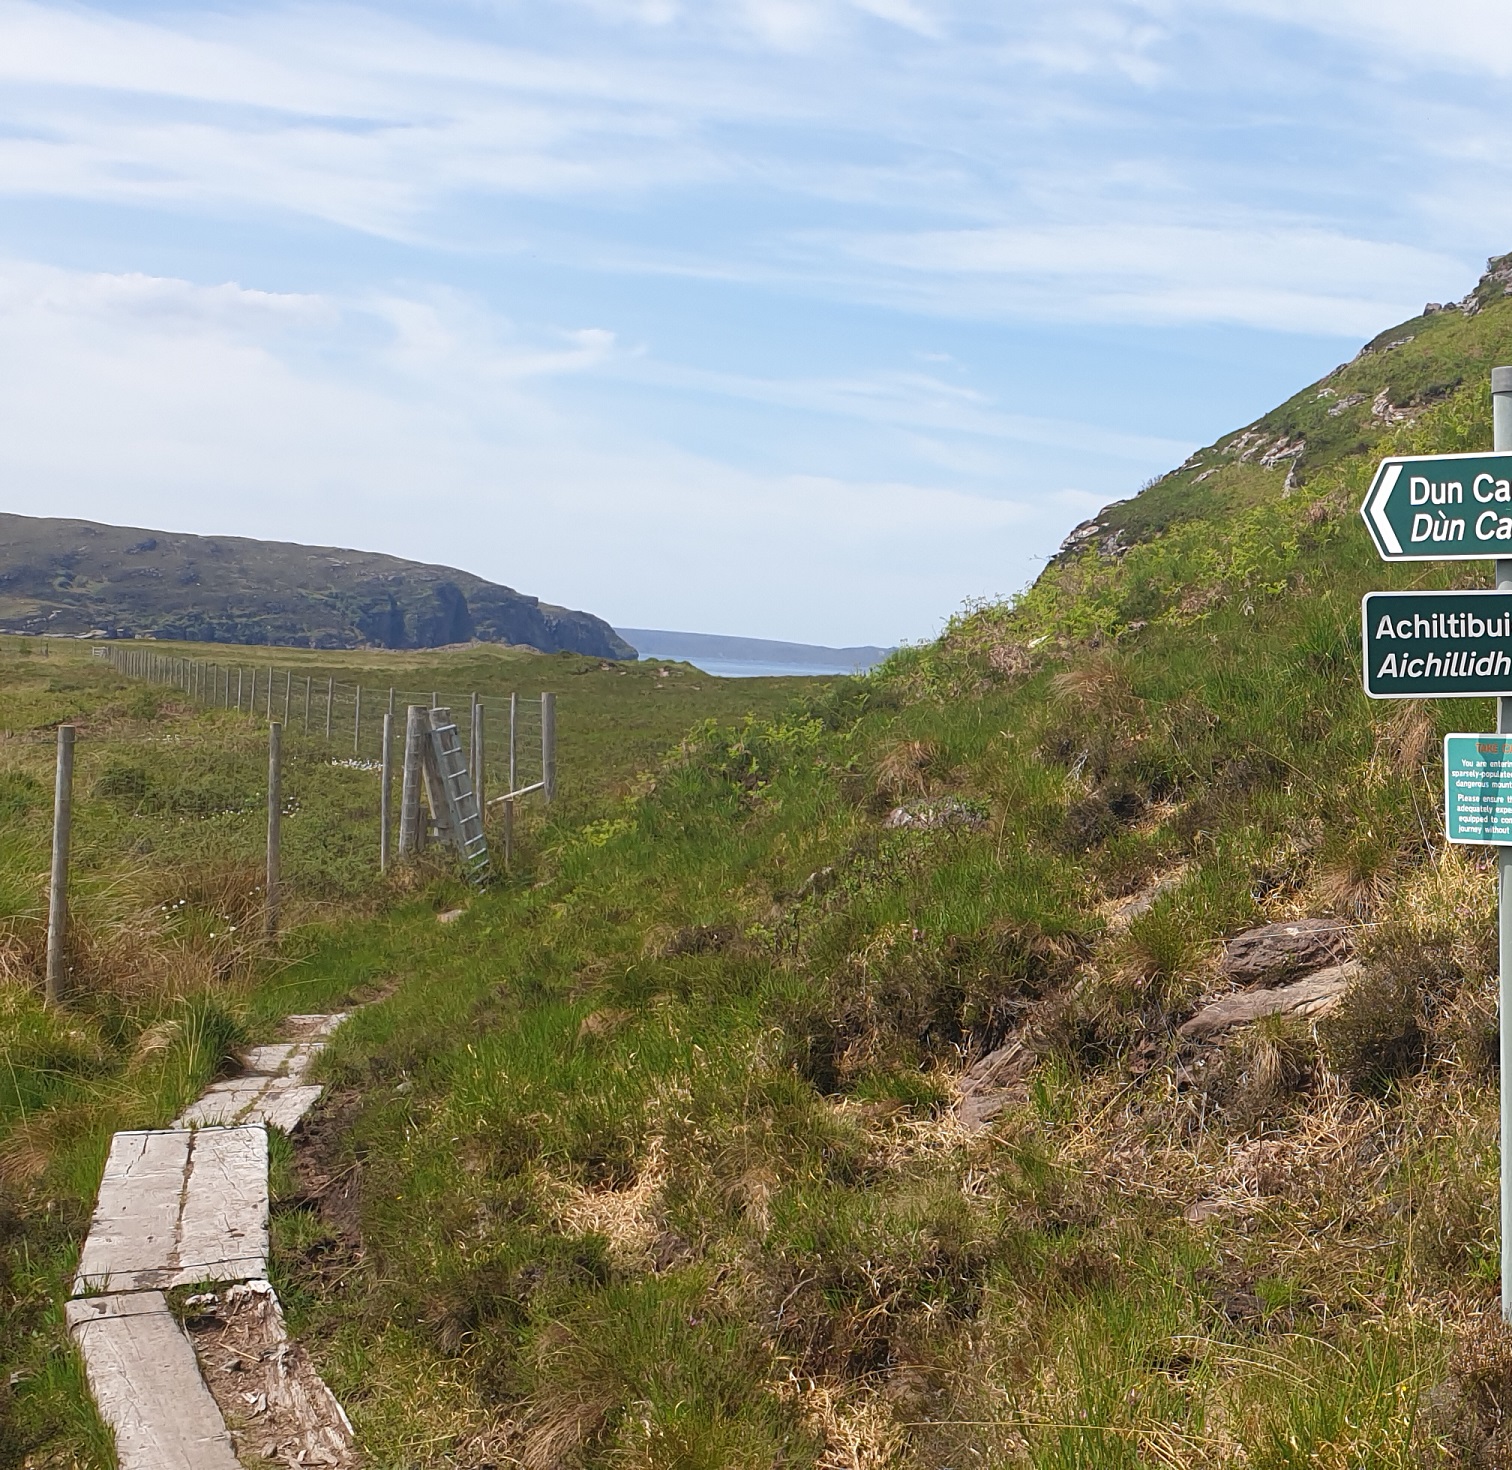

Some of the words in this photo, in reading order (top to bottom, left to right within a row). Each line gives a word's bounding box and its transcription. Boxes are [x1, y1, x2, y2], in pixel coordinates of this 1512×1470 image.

[1409, 477, 1463, 505] Dun
[1411, 510, 1465, 543] Dùn
[1377, 653, 1512, 678] Aichillidh
[1475, 743, 1498, 753] TAKE
[1462, 759, 1473, 767] You
[1456, 780, 1489, 788] dangerous
[1458, 794, 1480, 802] Please
[1457, 805, 1492, 814] adequately
[1459, 815, 1488, 823] equipped
[1459, 825, 1482, 834] journey
[1485, 826, 1509, 834] without
